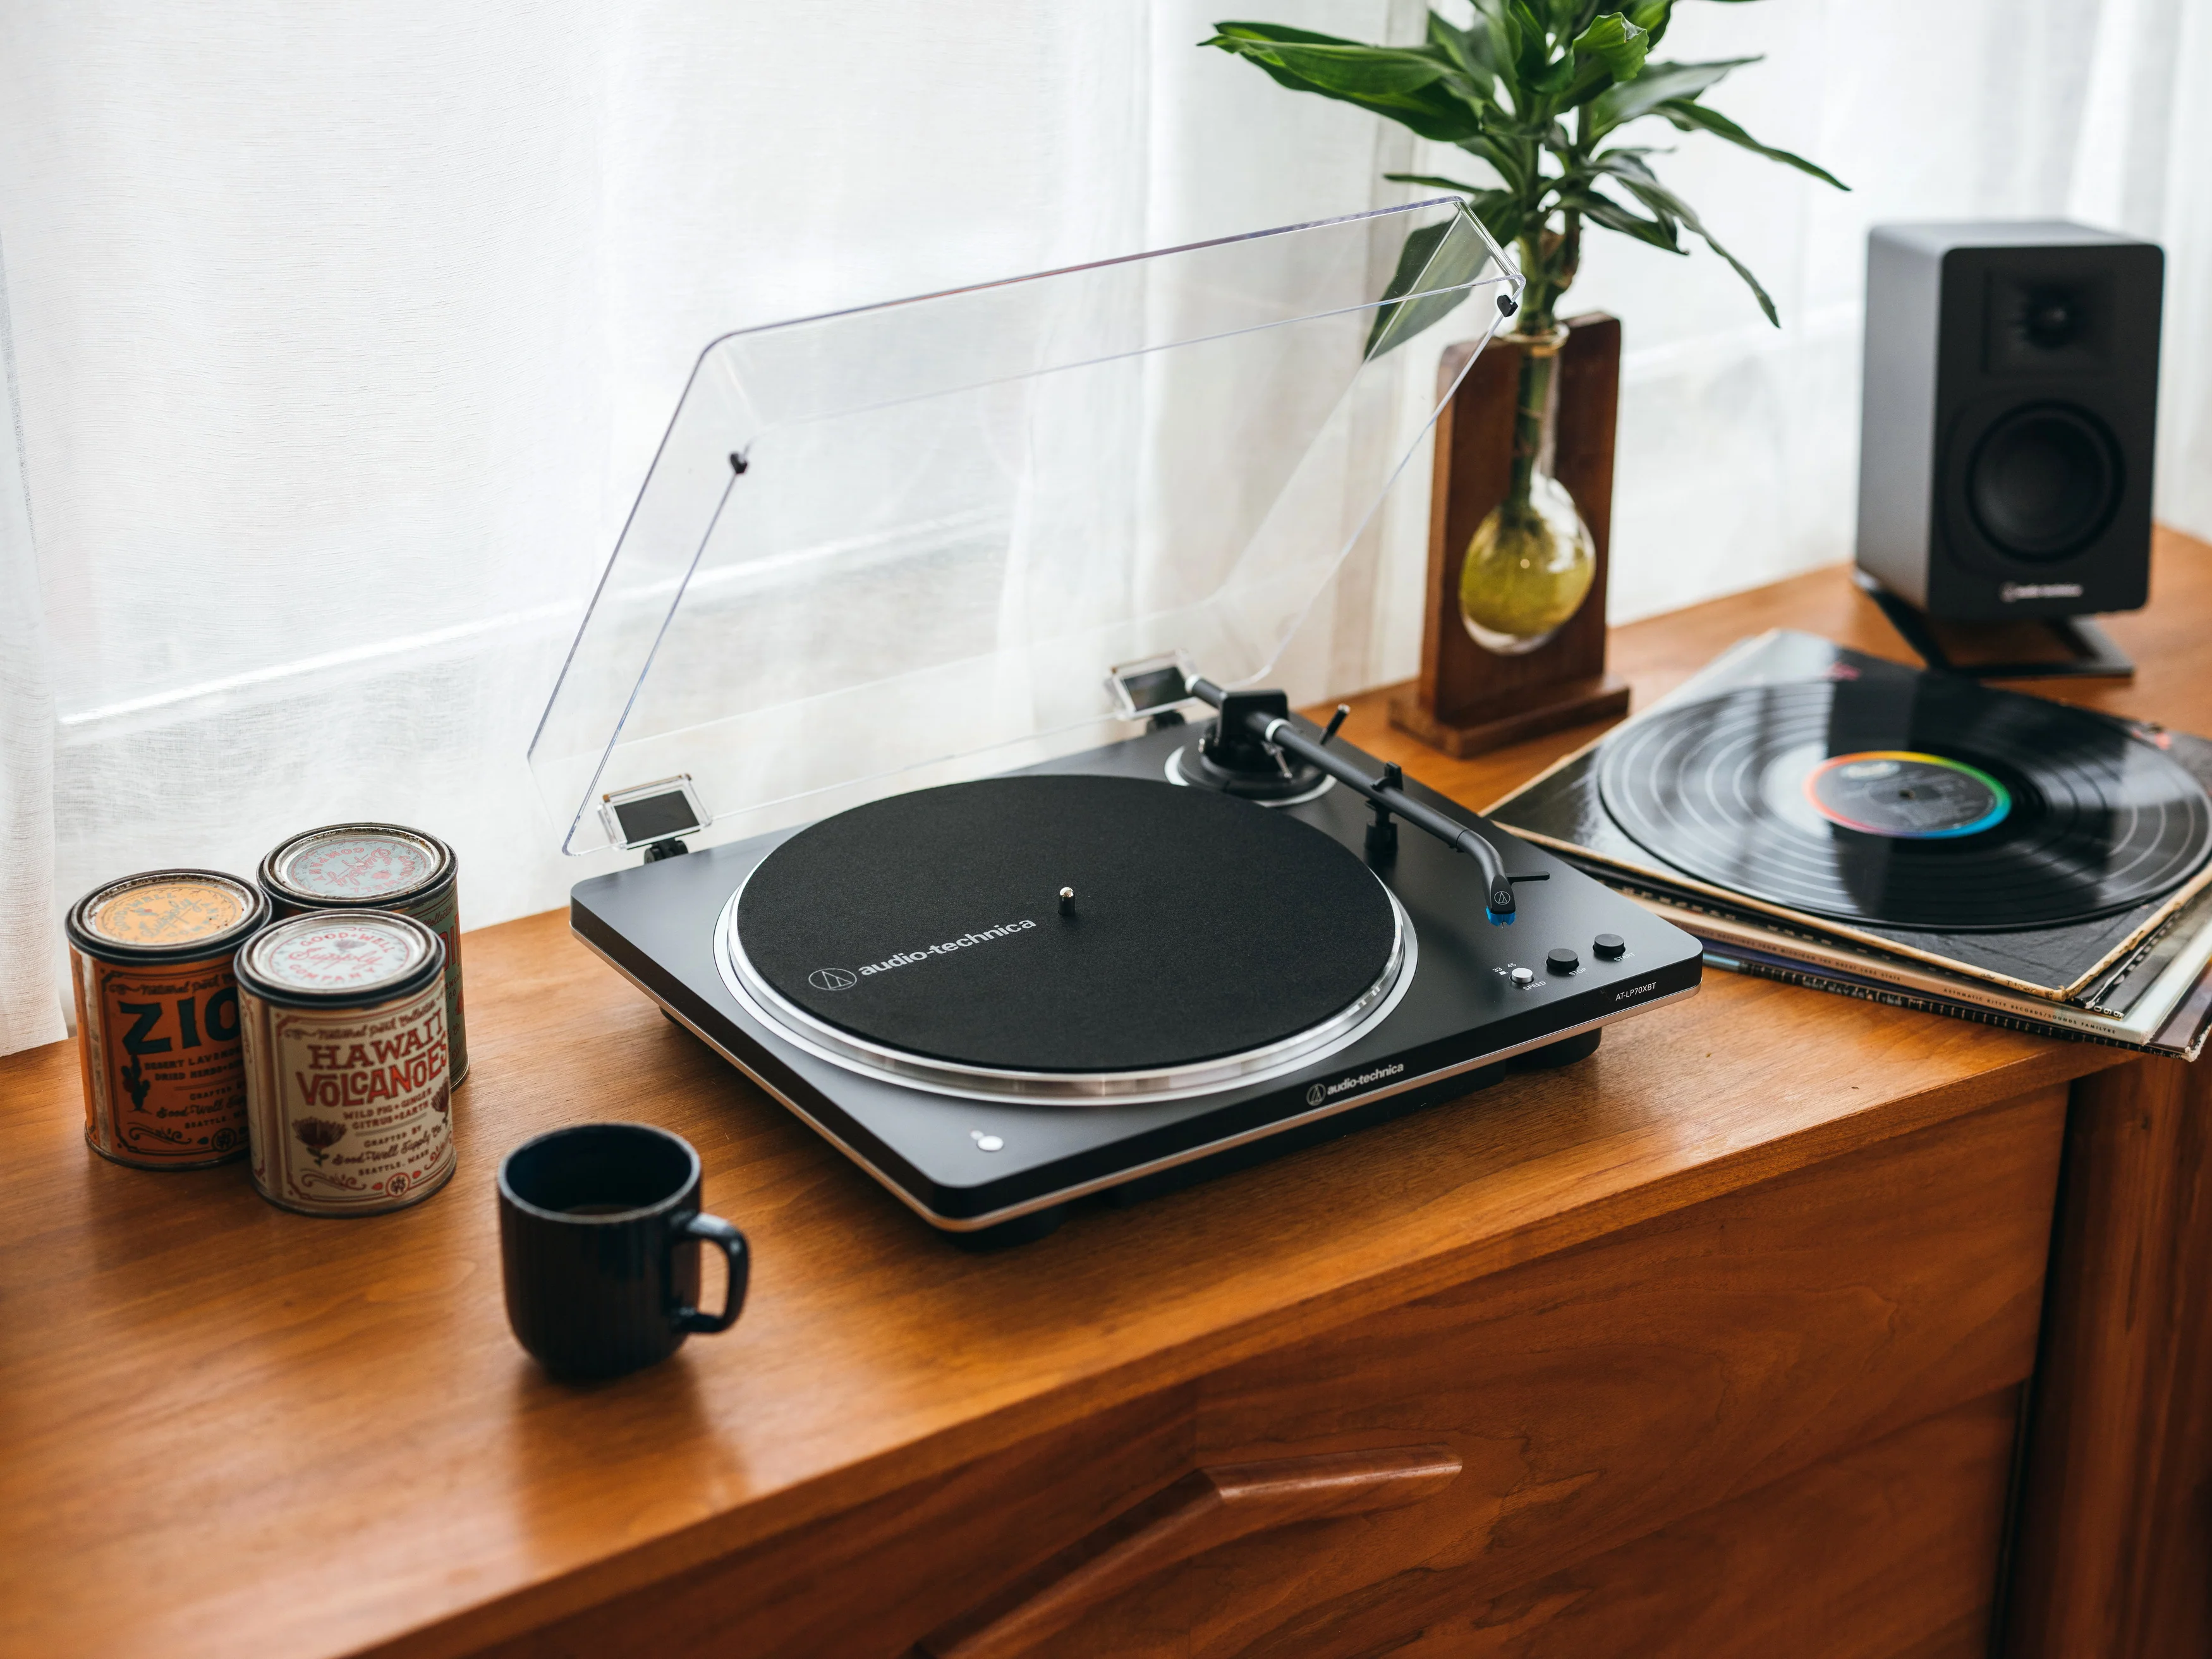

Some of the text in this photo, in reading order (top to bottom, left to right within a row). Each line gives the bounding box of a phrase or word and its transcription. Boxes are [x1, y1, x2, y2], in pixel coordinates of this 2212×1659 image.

[858, 920, 1036, 976] audio-technica
[1613, 952, 1636, 962] START
[1569, 968, 1587, 976] STOP
[1522, 981, 1547, 991] SPEED
[1615, 981, 1656, 1001] AT-LP70XBT
[307, 1008, 442, 1069] HAWAII
[2081, 1022, 2117, 1035] FAMILYRE
[295, 1031, 447, 1107] VOLCANOES
[1327, 1064, 1404, 1095] audio-technica
[343, 1109, 374, 1119] WILD
[364, 1124, 422, 1148] CRAFTED BY
